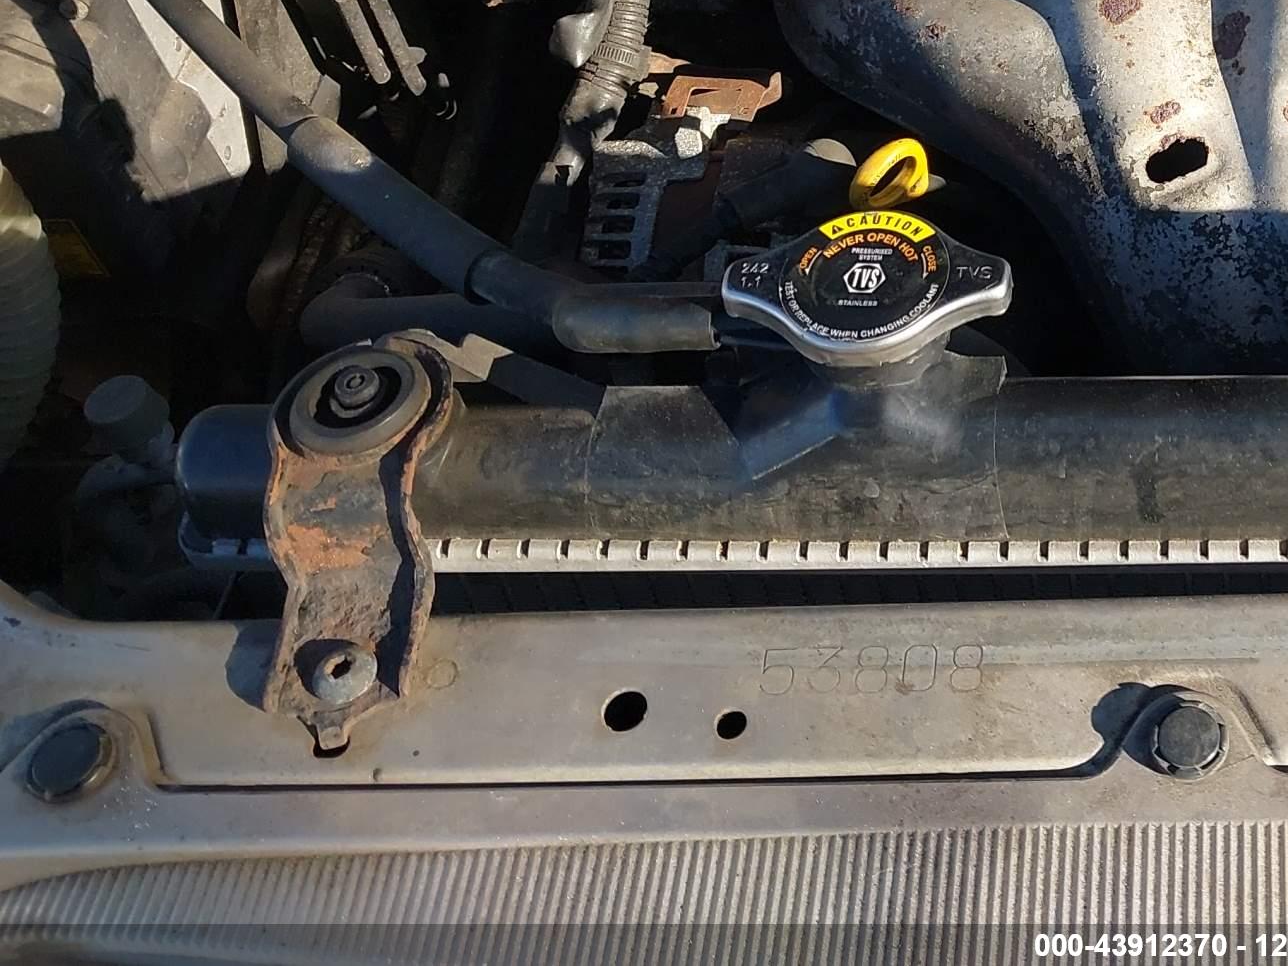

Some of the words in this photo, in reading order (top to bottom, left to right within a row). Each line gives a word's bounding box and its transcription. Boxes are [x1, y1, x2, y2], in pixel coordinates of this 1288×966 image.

[846, 215, 923, 237] CAUTION
[799, 247, 817, 270] OPEN
[823, 234, 864, 259] NEVER
[867, 232, 900, 248] OPEN
[899, 241, 919, 263] HOT
[922, 245, 937, 273] CLOSE
[741, 275, 761, 288] 1.1
[852, 267, 880, 289] TVS
[956, 266, 993, 279] TVS
[788, 298, 800, 312] OR
[830, 327, 859, 339] WHEN
[860, 316, 909, 338] CHANGING
[908, 284, 939, 318] COOLANT
[837, 299, 878, 307] STAINLESS
[759, 643, 984, 696] 53808
